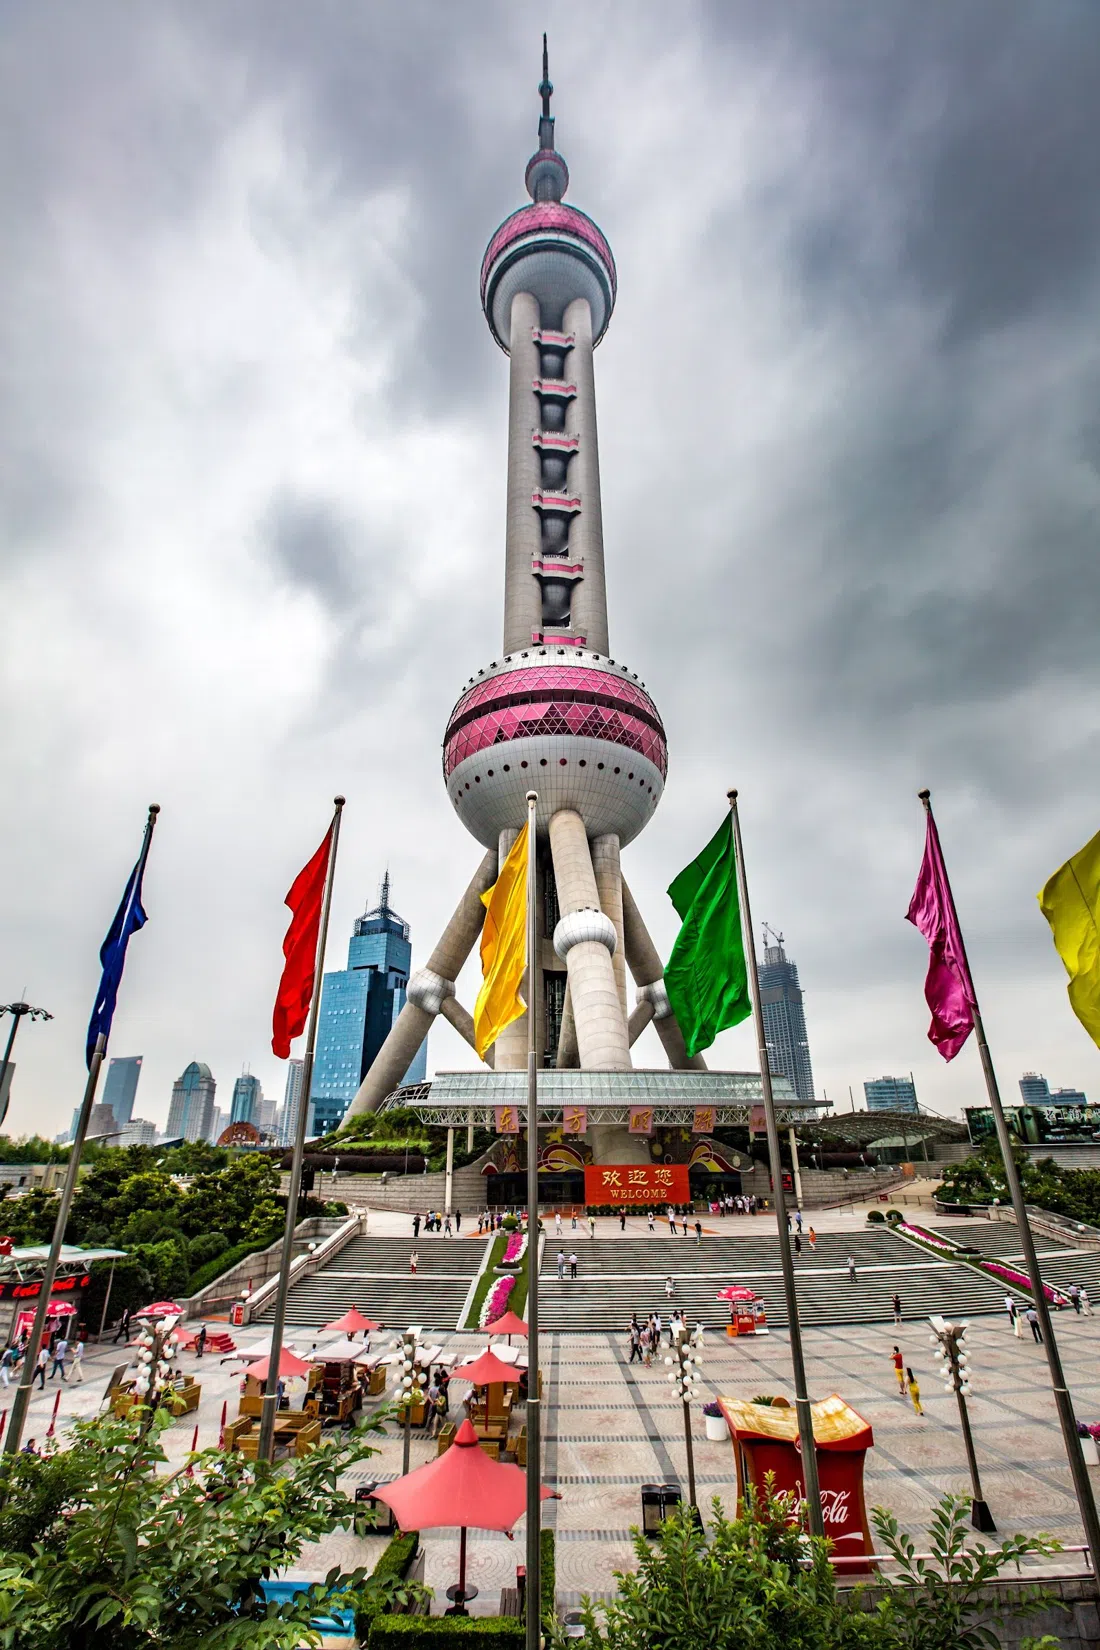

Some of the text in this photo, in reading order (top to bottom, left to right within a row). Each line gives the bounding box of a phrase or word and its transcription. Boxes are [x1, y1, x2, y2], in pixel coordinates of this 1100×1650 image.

[602, 1169, 675, 1187] 欢迎您
[610, 1189, 668, 1199] WELCOME
